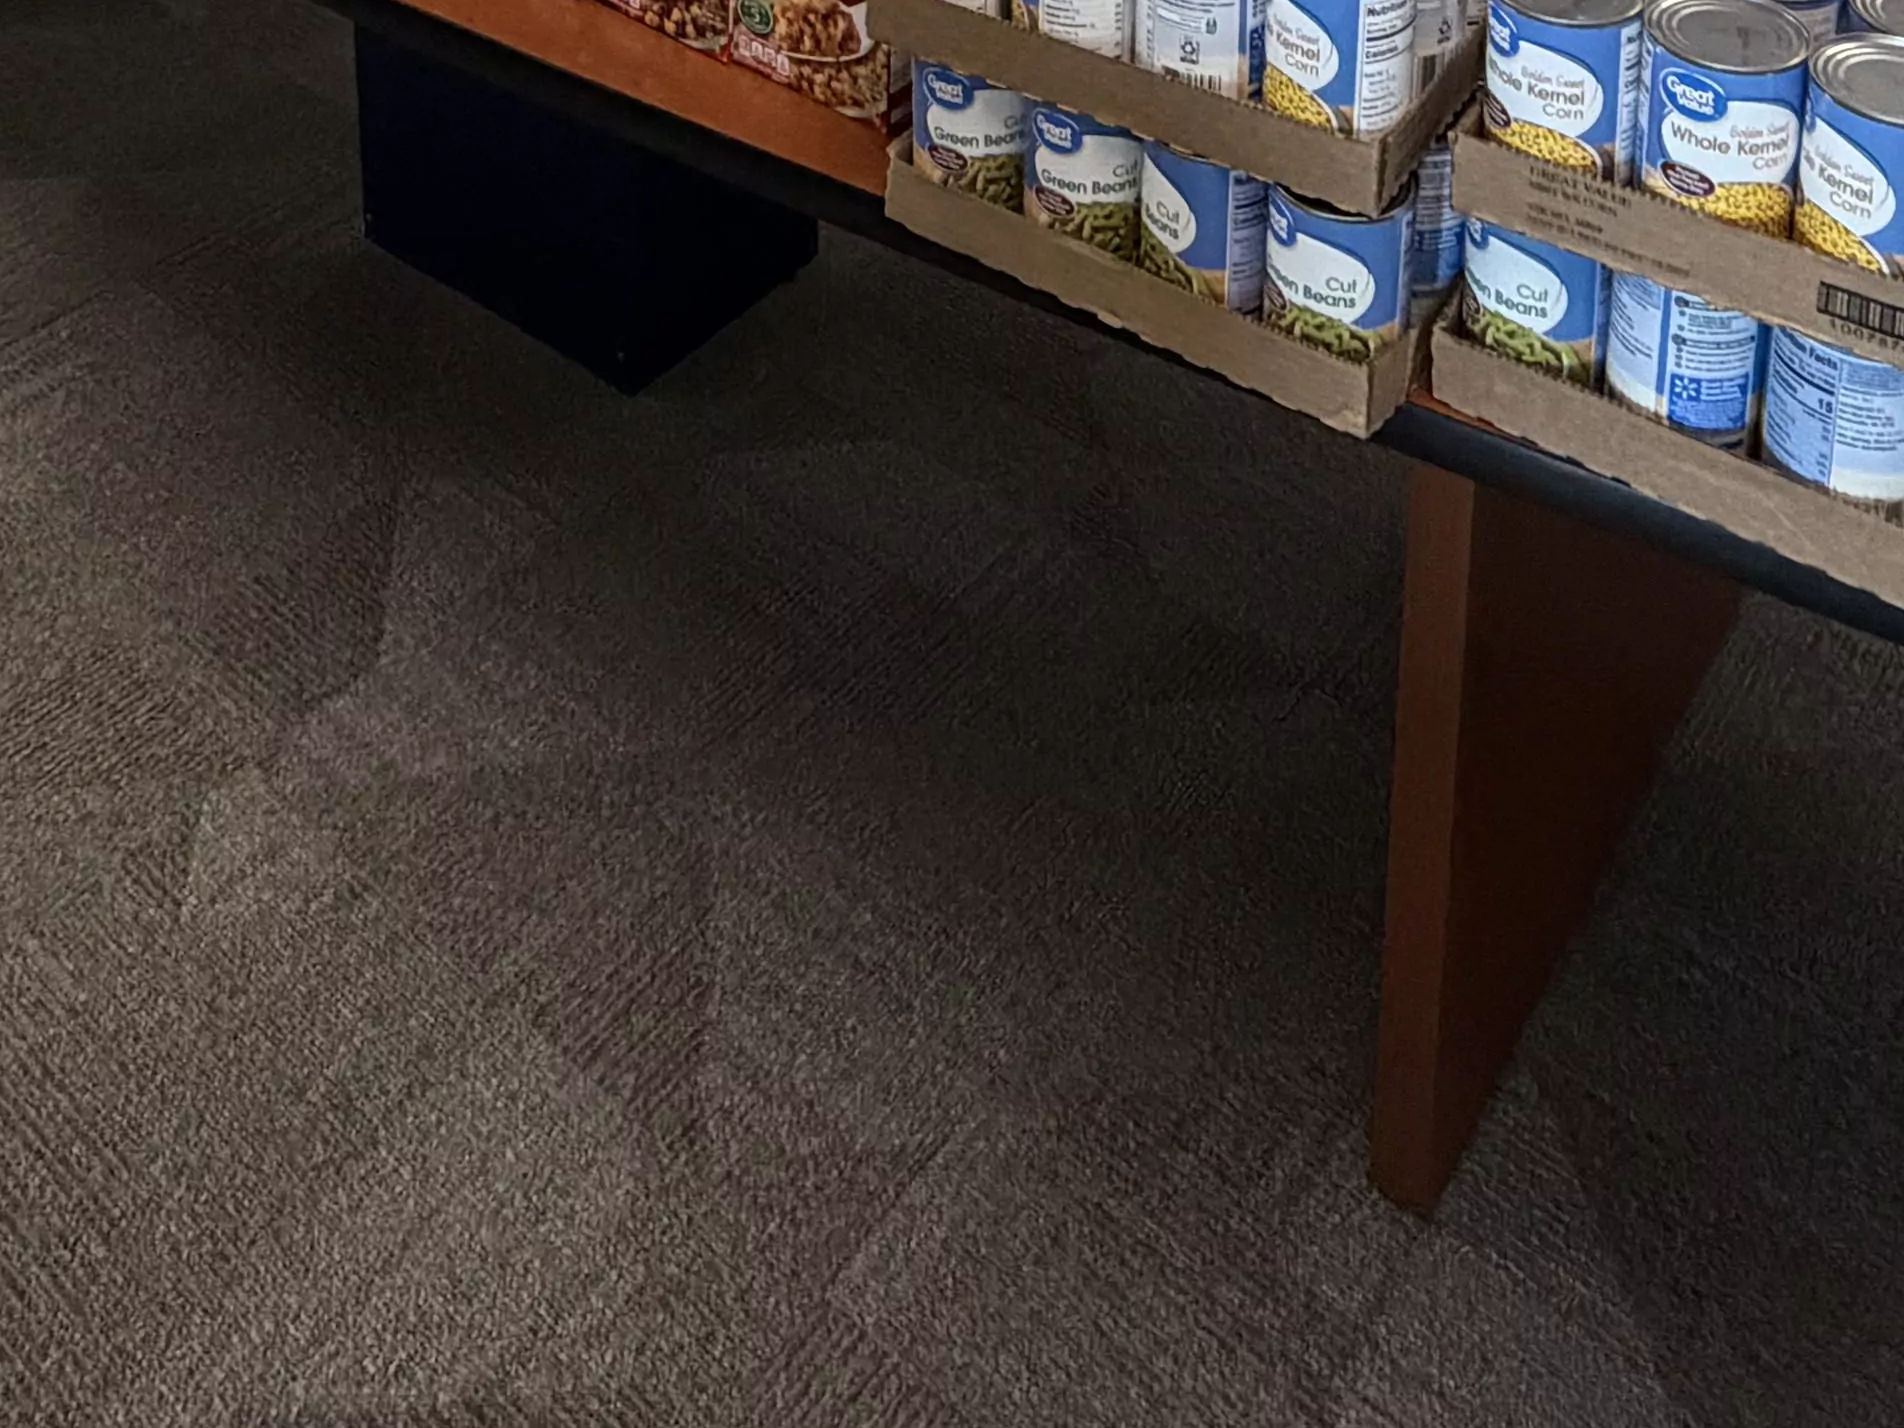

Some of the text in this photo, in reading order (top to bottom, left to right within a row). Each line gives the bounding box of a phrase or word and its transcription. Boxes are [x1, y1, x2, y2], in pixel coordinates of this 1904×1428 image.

[1276, 31, 1321, 64] Kernel
[1284, 53, 1320, 78] Corn
[1528, 80, 1585, 106] Kernel
[1666, 75, 1715, 107] Great
[1542, 99, 1585, 121] Corn
[934, 126, 980, 149] Green
[1671, 121, 1790, 156] Whole Kernel
[1752, 154, 1789, 171] Corn
[1041, 168, 1087, 195] Green
[1817, 163, 1874, 205] Kernel
[1156, 201, 1181, 225] Cut
[1829, 191, 1872, 221] Corn
[1303, 284, 1357, 310] Beans
[1325, 275, 1357, 294] Cut
[1516, 283, 1549, 303] Cut
[1494, 286, 1549, 319] Beans
[1817, 397, 1834, 415] 15
